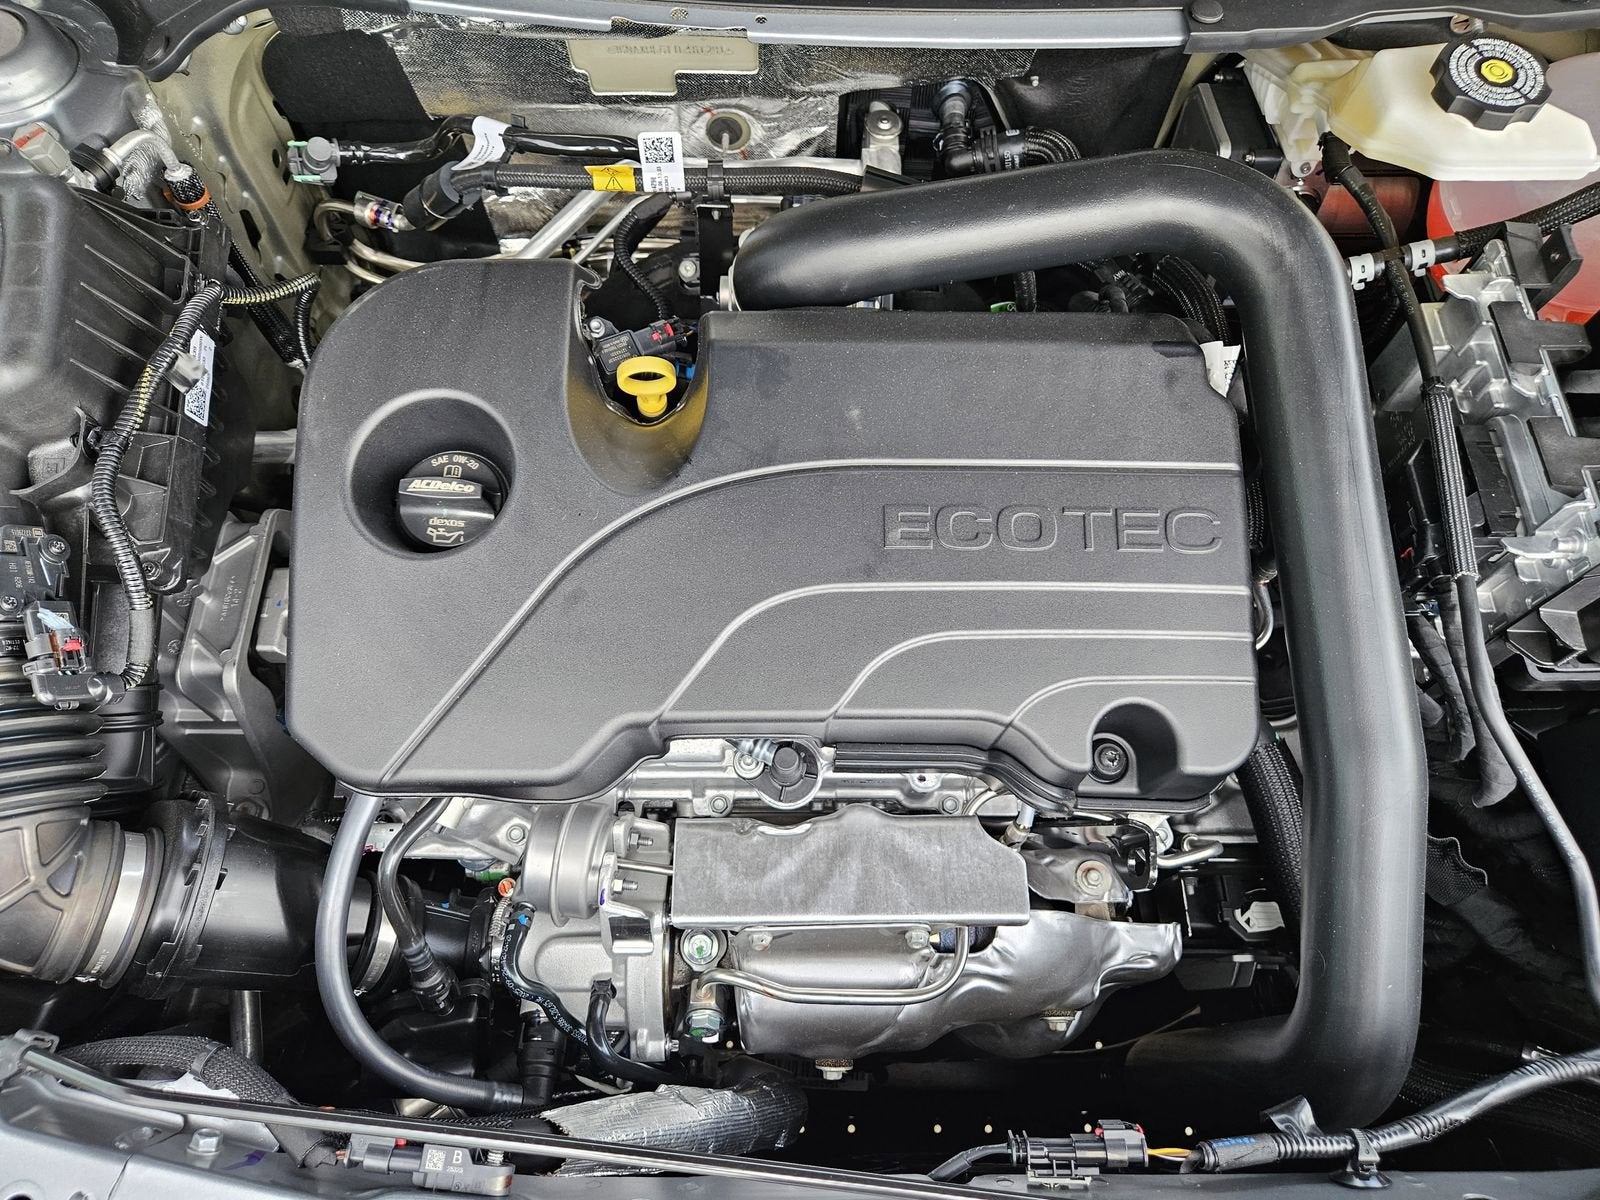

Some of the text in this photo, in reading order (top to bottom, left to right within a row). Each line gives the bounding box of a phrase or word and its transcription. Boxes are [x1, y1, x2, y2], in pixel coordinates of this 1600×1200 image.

[431, 455, 480, 470] SAE 0W-20
[406, 479, 475, 493] ACDelco
[429, 517, 465, 527] dexos
[882, 503, 1223, 555] ECOTEC
[452, 1149, 463, 1164] B
